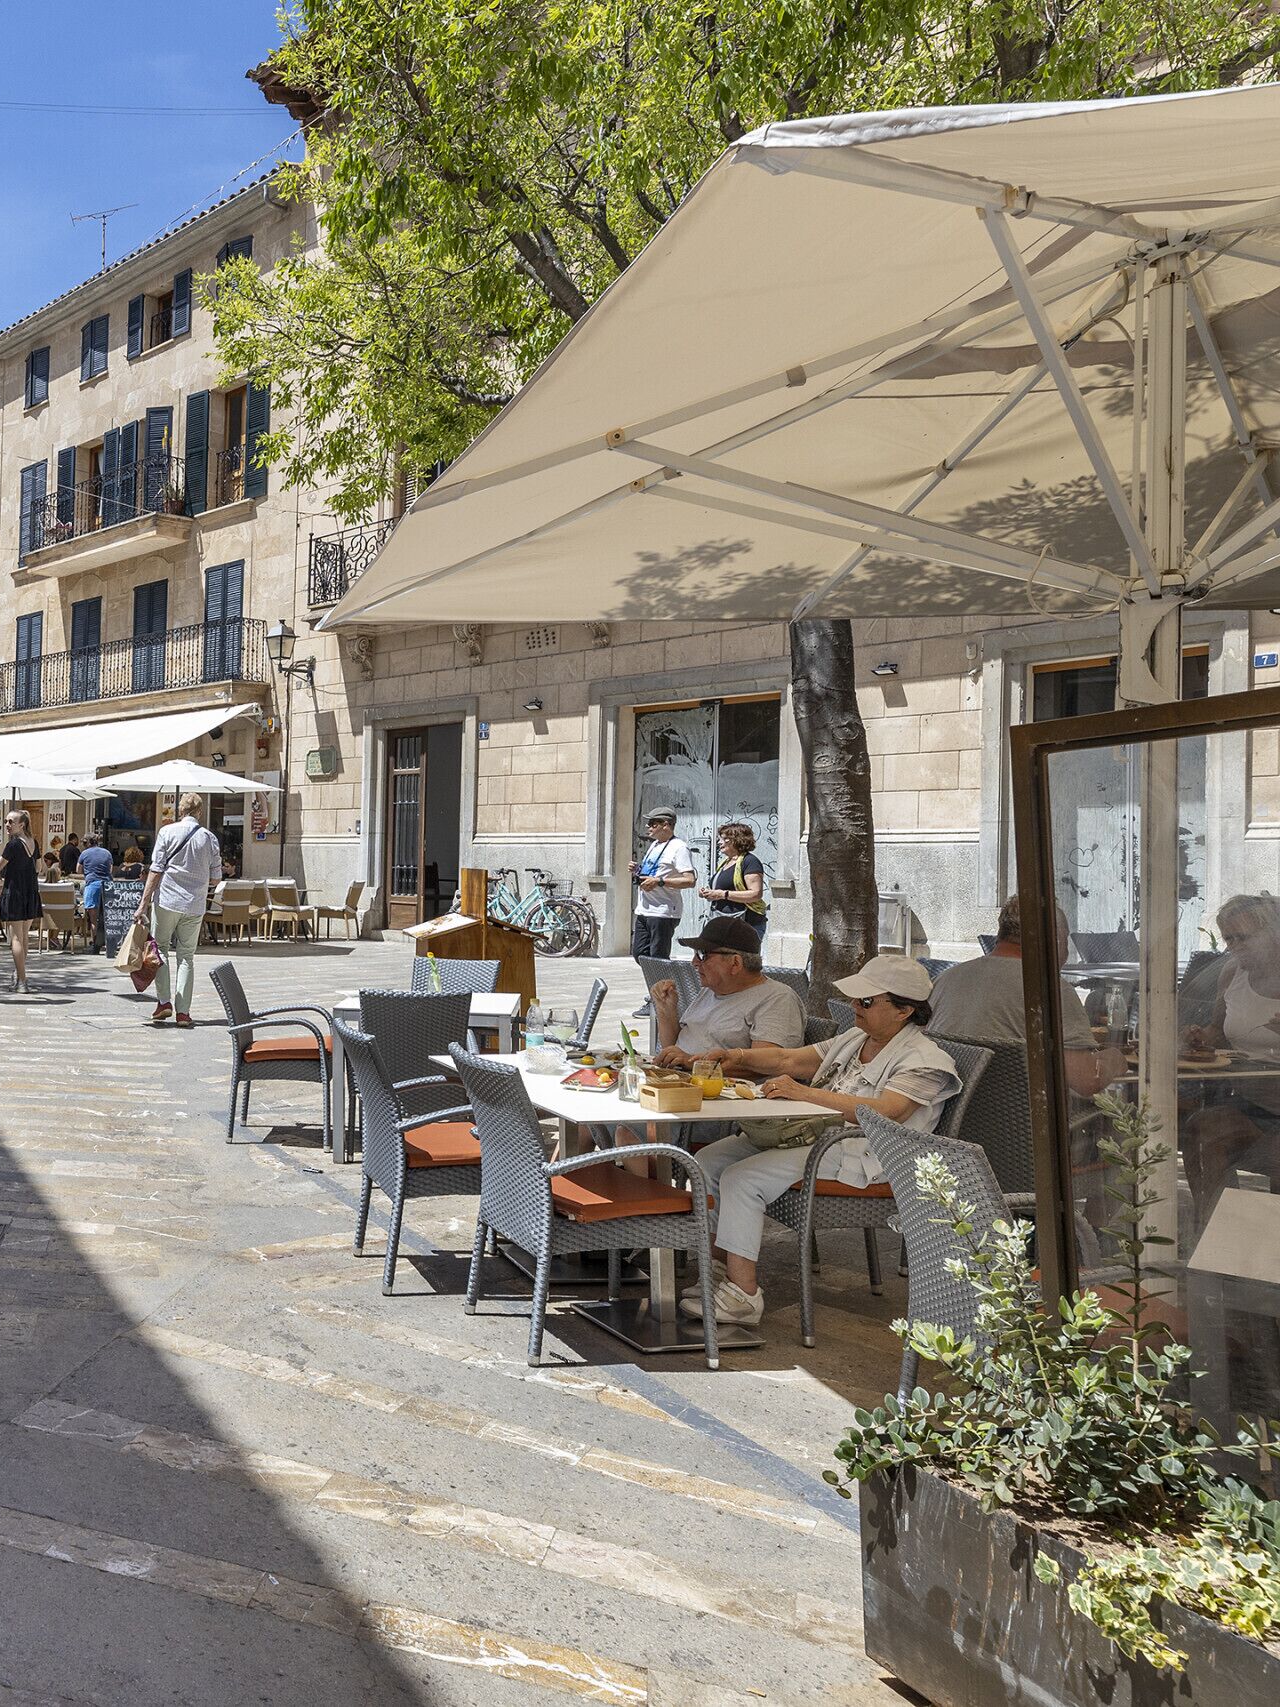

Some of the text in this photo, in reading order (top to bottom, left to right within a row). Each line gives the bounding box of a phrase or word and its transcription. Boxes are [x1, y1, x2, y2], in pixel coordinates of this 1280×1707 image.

[1261, 655, 1269, 665] 7
[49, 813, 64, 822] PASTA
[48, 824, 64, 833] PIZZA
